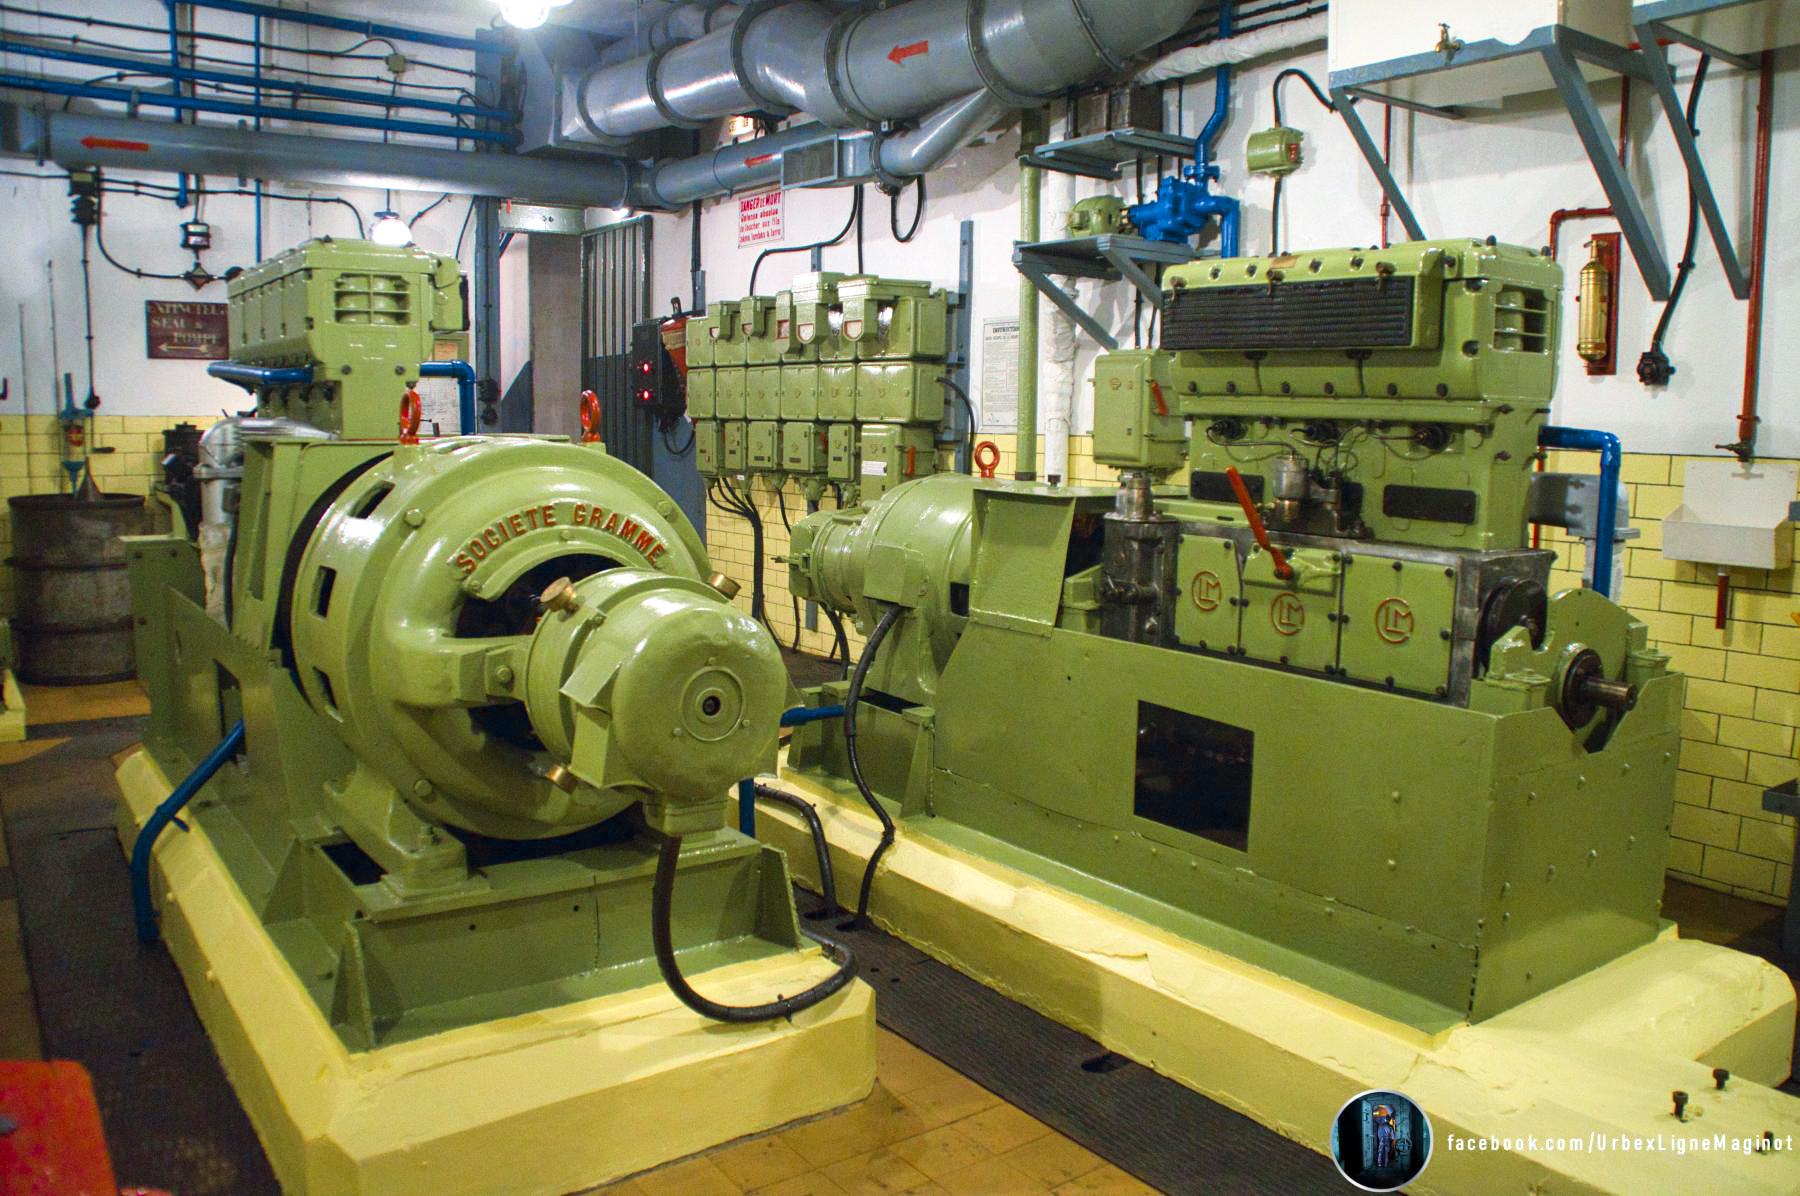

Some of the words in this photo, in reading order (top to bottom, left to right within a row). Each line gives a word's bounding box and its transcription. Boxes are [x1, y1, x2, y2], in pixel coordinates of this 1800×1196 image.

[741, 198, 760, 212] DANGER
[765, 192, 781, 205] MORT
[455, 504, 557, 574] SOCIETE
[573, 504, 667, 565] GRAMME
